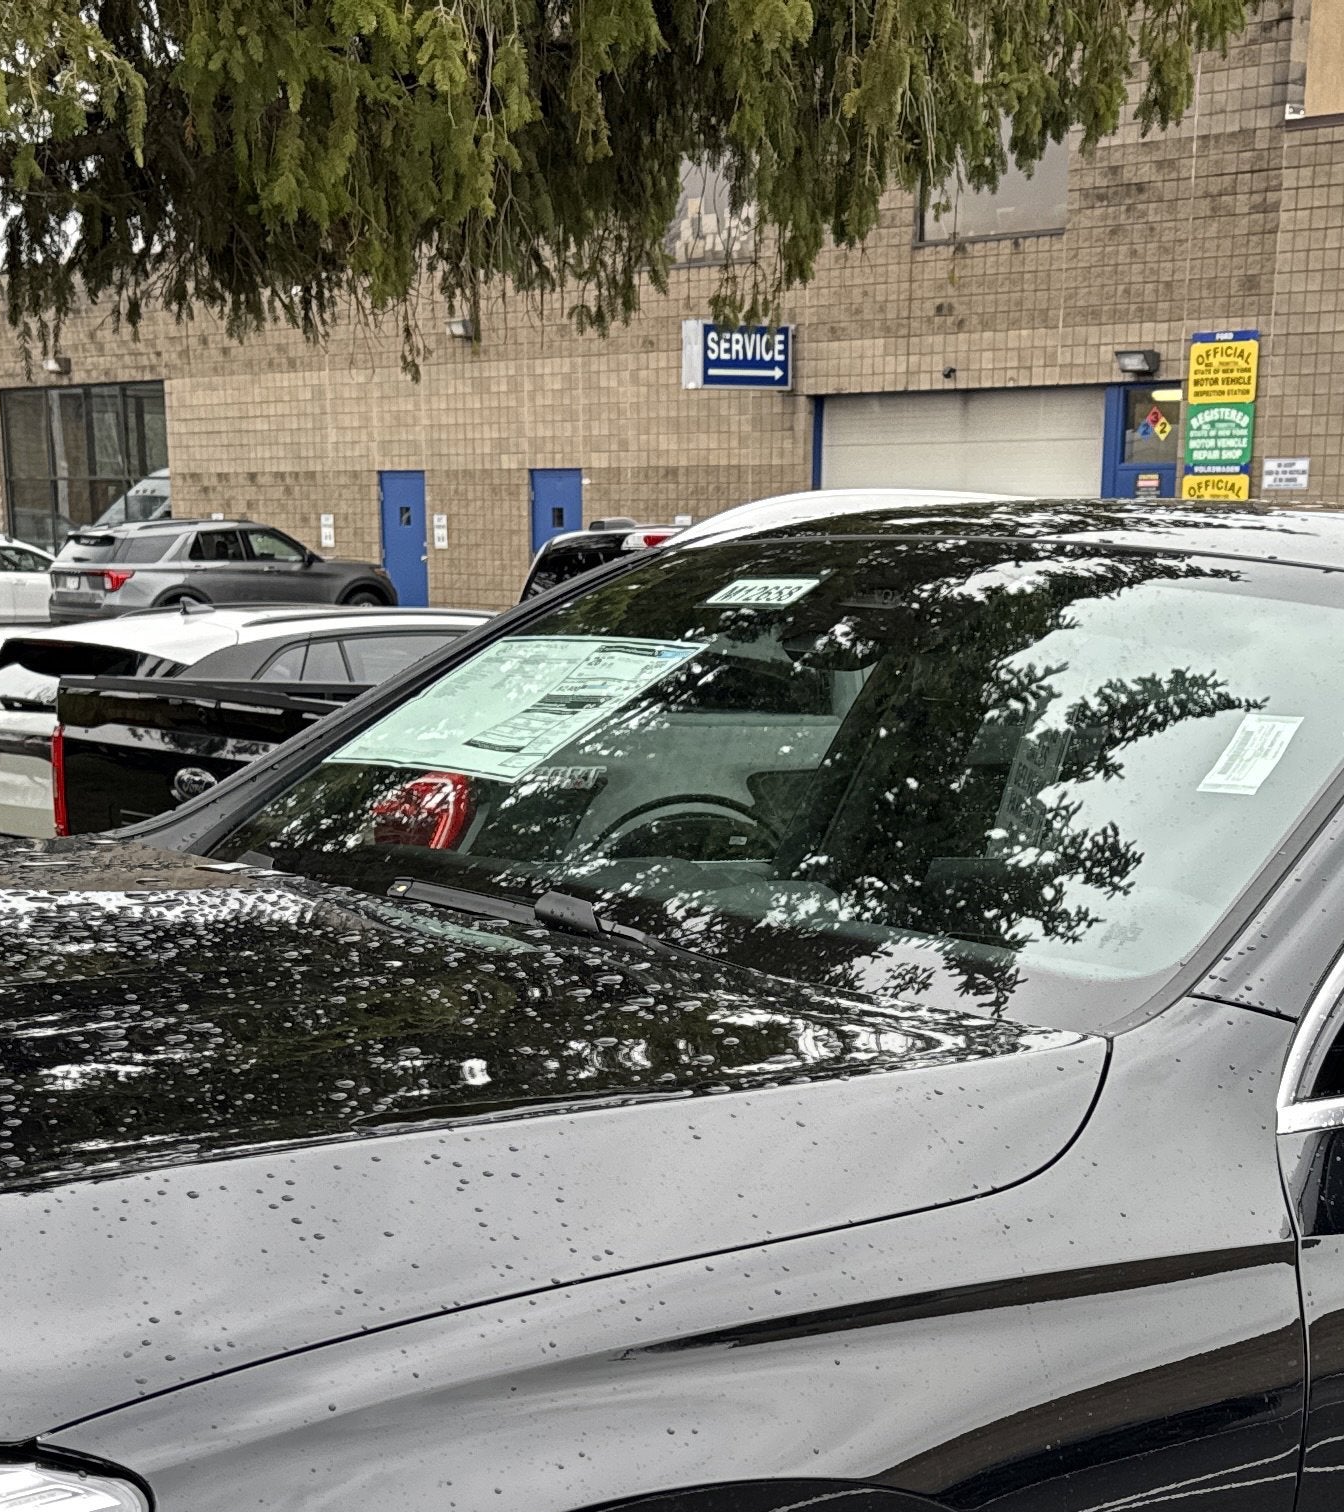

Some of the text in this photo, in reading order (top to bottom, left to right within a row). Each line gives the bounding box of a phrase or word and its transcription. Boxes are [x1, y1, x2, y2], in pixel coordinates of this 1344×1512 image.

[706, 331, 786, 361] SERVICE
[1196, 345, 1252, 366] OFFICIAL
[1193, 375, 1252, 387] MOTOR VEHICLE
[1151, 411, 1160, 422] 3
[1190, 407, 1250, 430] REGISTERED
[1143, 422, 1168, 434] 2 2
[1189, 437, 1248, 449] MOTOR VEHICLE
[1192, 449, 1243, 461] REPAIR SHOP
[1188, 479, 1243, 498] OFFICIAL
[715, 586, 804, 602] M12658
